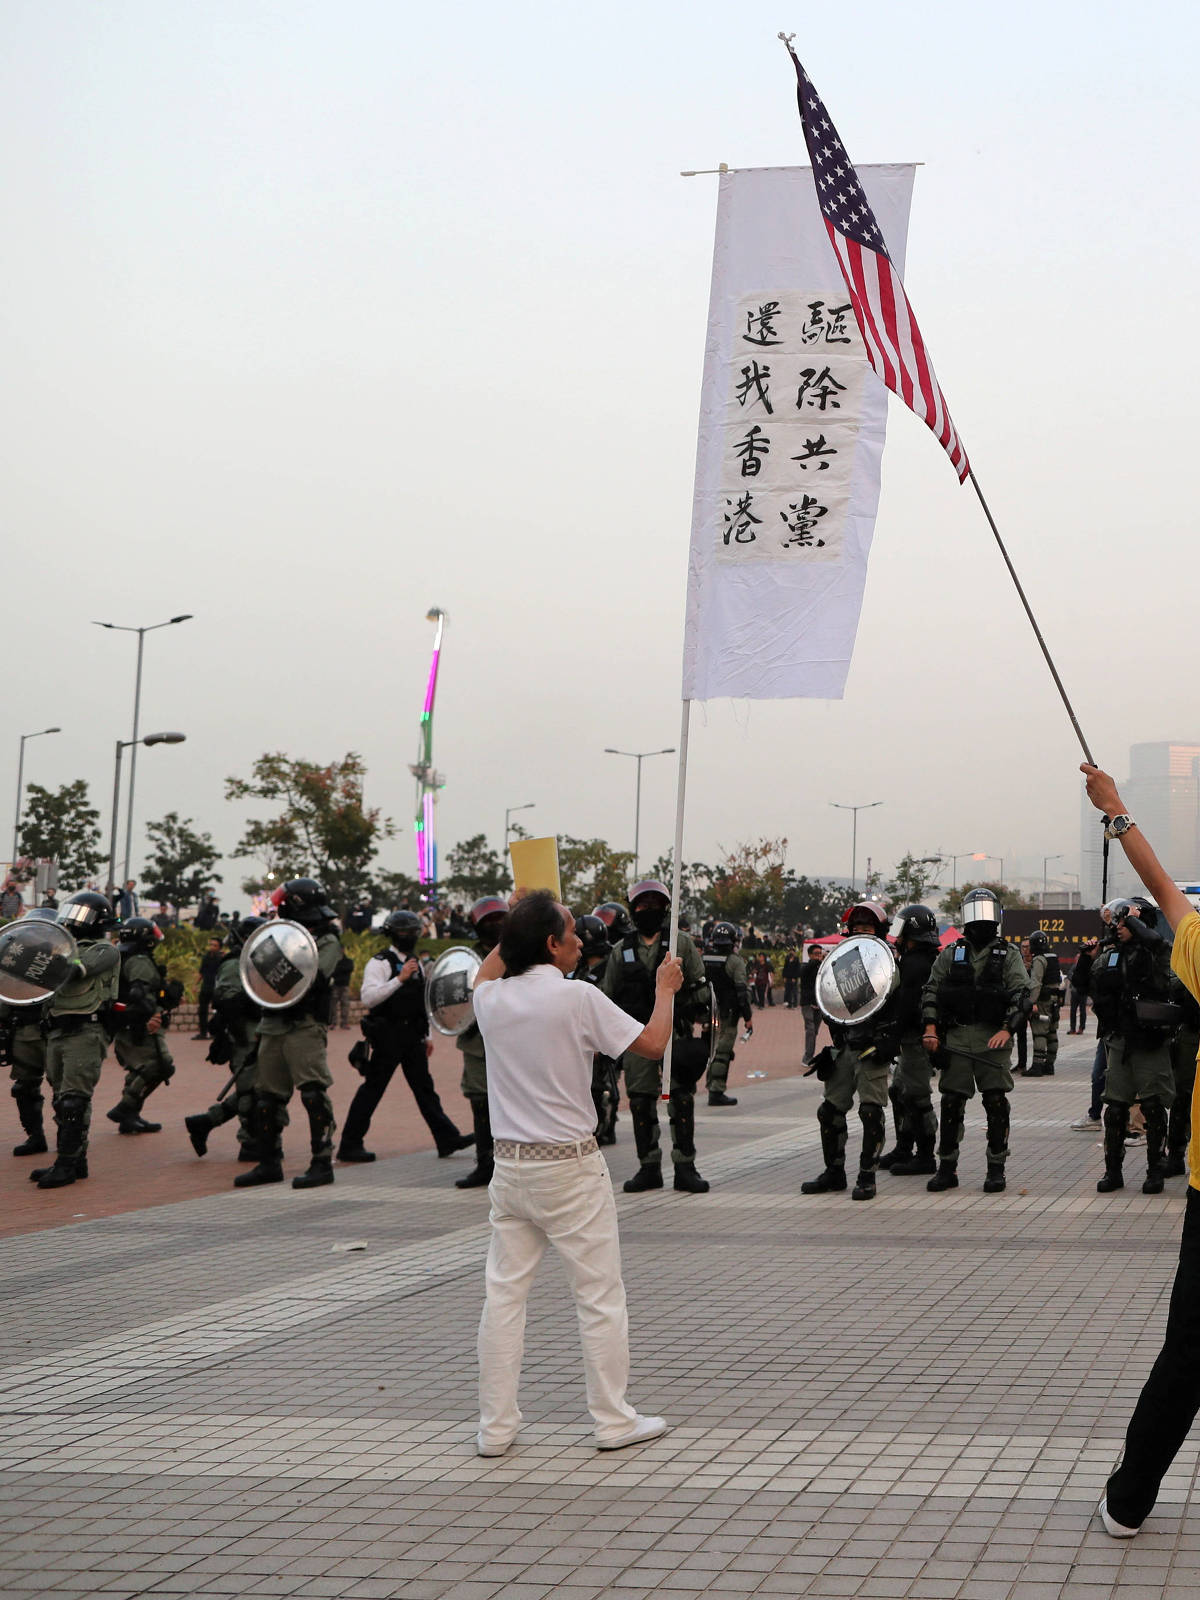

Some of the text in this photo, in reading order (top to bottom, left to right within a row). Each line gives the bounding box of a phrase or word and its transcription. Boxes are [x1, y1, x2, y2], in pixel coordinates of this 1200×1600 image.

[722, 301, 785, 546] 還我香港
[780, 300, 853, 549] 驅除共黨
[1039, 919, 1065, 932] 12.22
[25, 951, 52, 980] POLICE
[839, 971, 869, 997] POLICE
